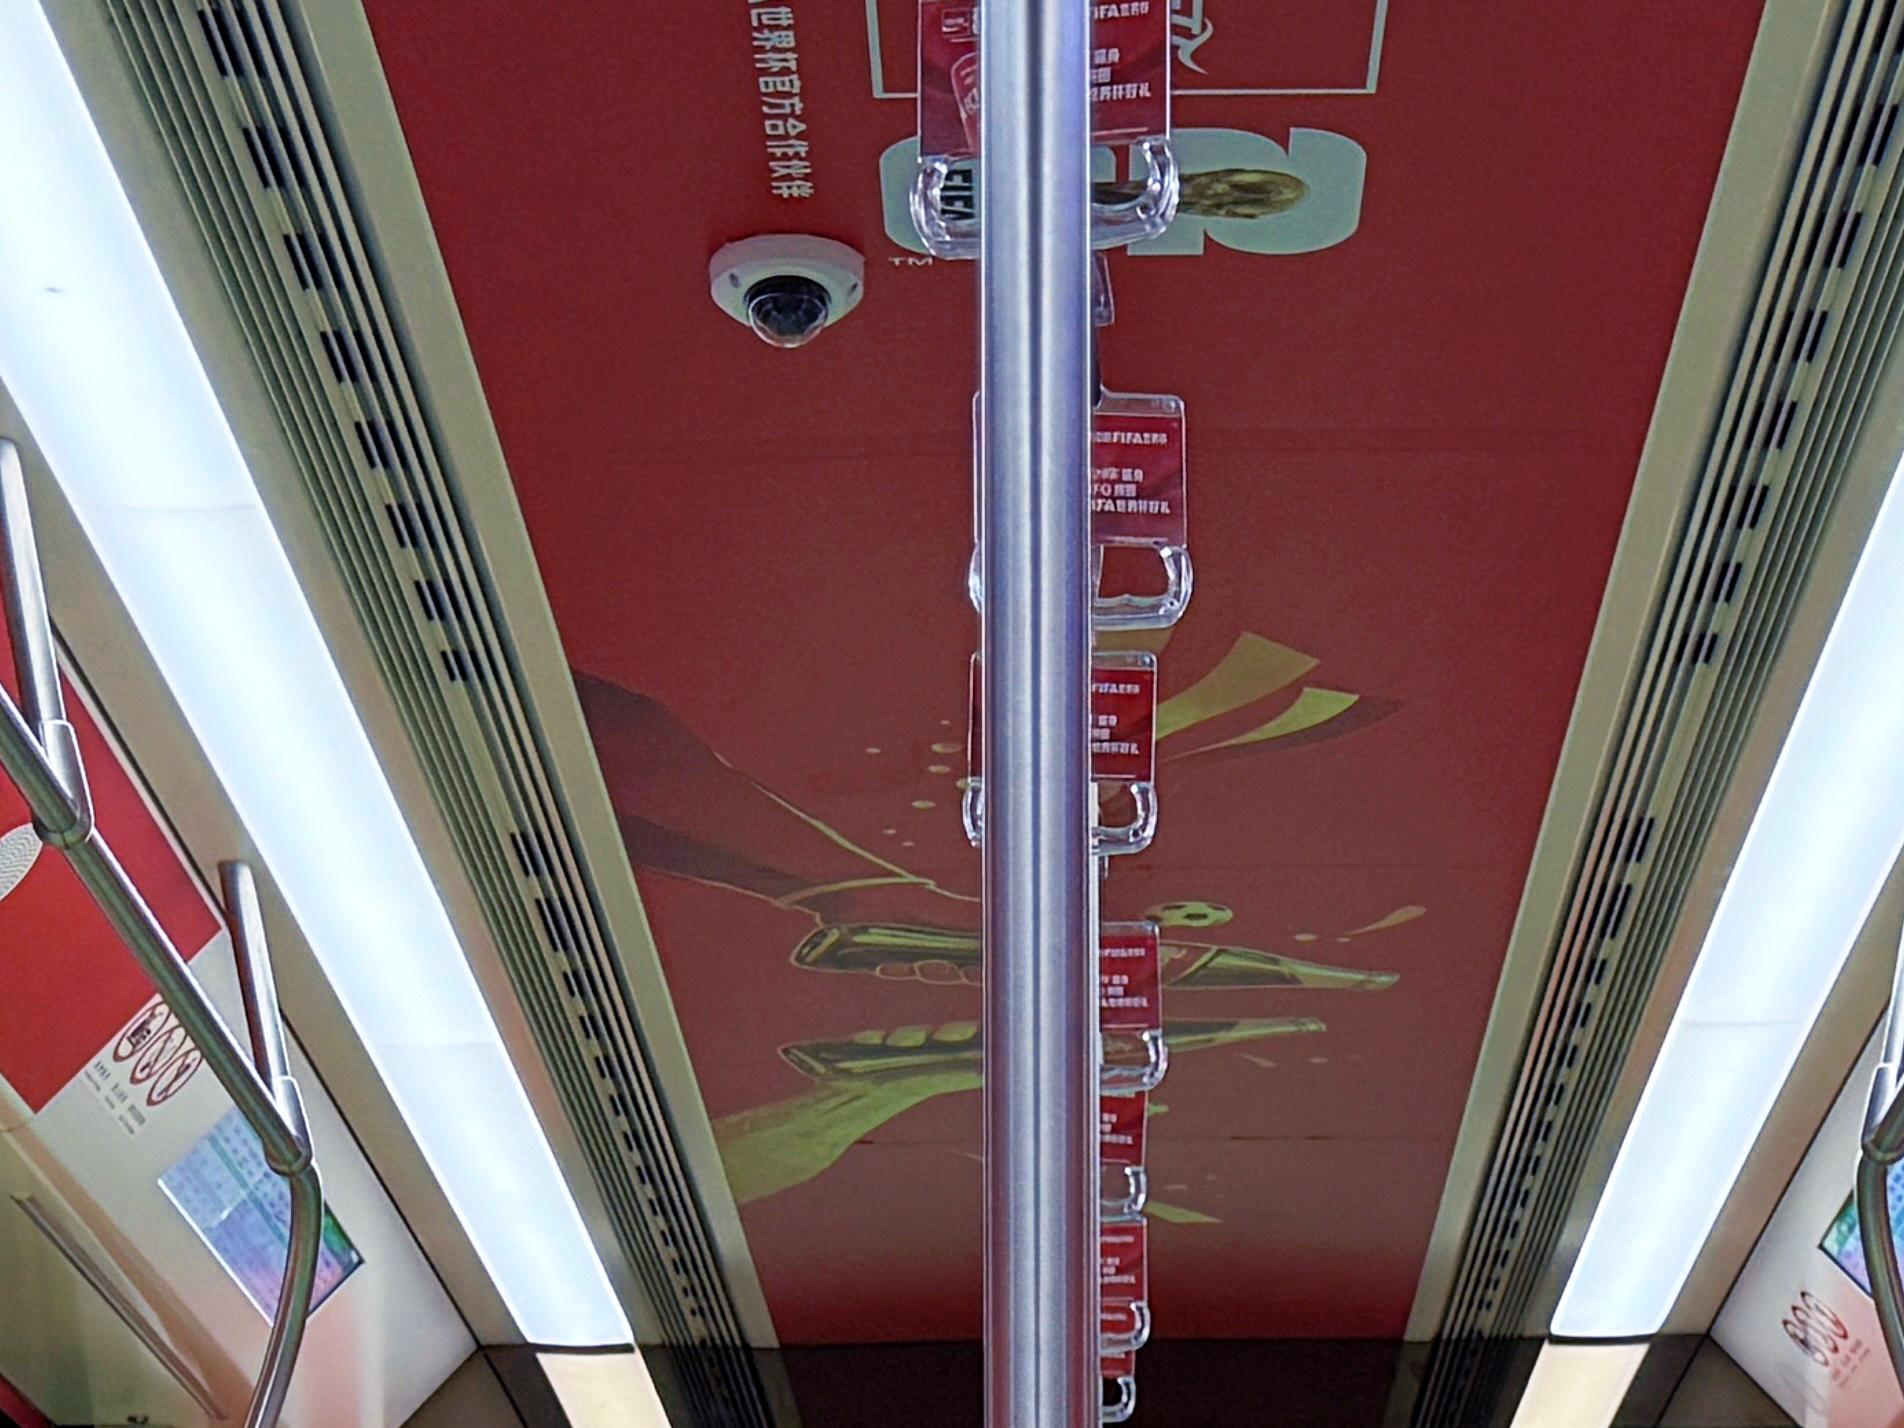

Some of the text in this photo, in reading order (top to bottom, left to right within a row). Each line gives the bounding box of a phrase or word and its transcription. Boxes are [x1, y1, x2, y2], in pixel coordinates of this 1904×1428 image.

[748, 0, 815, 198] 世界杯官方合作伙伴
